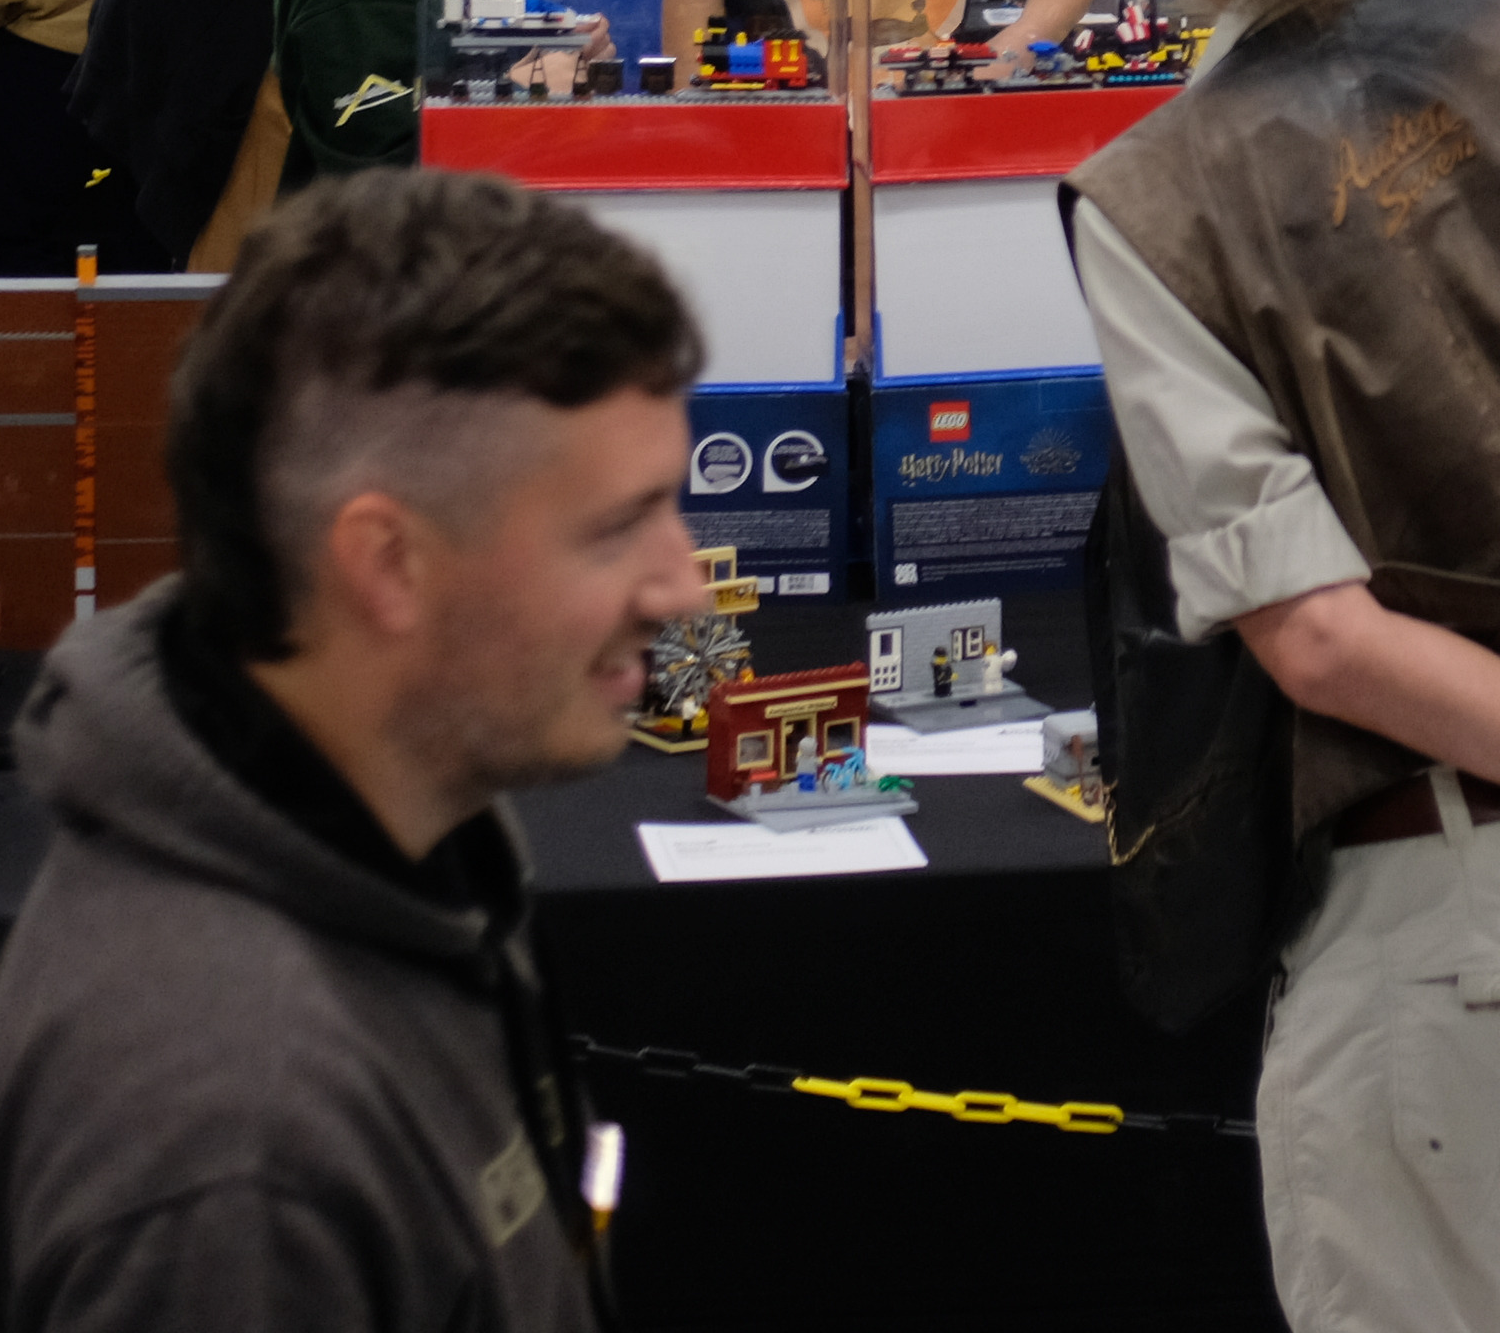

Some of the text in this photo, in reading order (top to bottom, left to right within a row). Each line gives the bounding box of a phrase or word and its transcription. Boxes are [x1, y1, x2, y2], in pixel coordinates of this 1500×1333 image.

[933, 412, 969, 430] LEGO
[899, 452, 950, 487] Harry
[950, 447, 1004, 477] Potter
